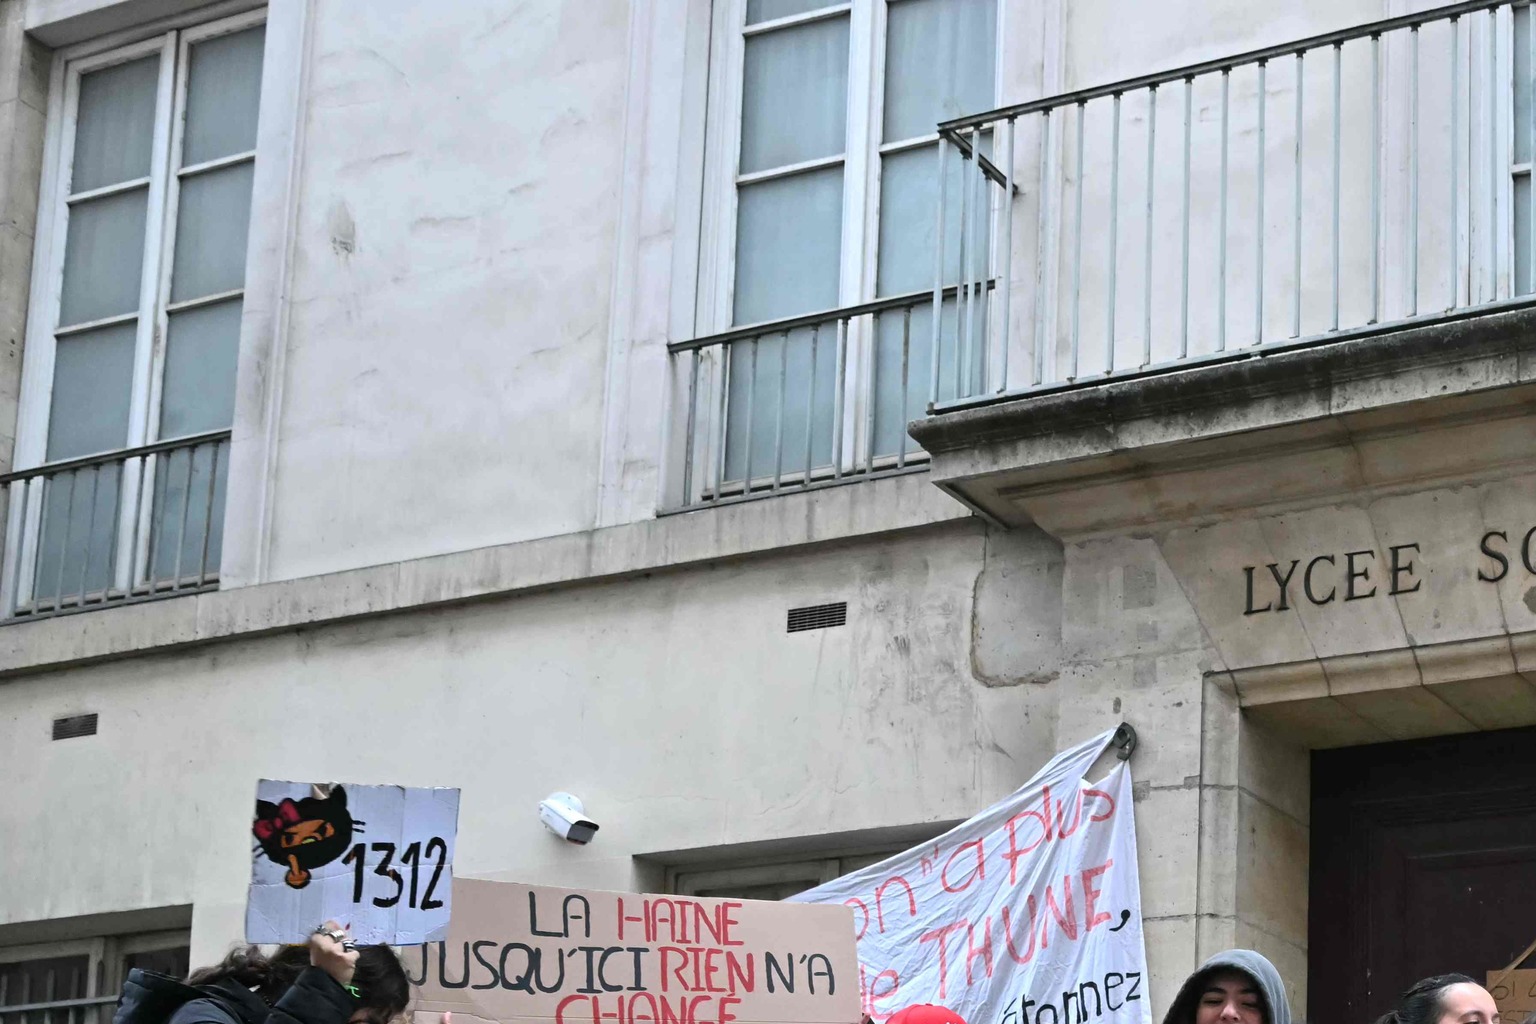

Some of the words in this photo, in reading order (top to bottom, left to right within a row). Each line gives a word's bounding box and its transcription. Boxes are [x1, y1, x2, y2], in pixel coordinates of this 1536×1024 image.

[1243, 543, 1422, 616] LYCEE
[1001, 785, 1116, 886] plus
[342, 836, 447, 911] 1312
[529, 891, 591, 938] LA
[617, 897, 745, 946] HAINE
[920, 859, 1131, 1000] THUNE,
[406, 940, 650, 995] JUSQU'ICI
[658, 945, 755, 994] RIEN
[764, 950, 835, 996] N'A
